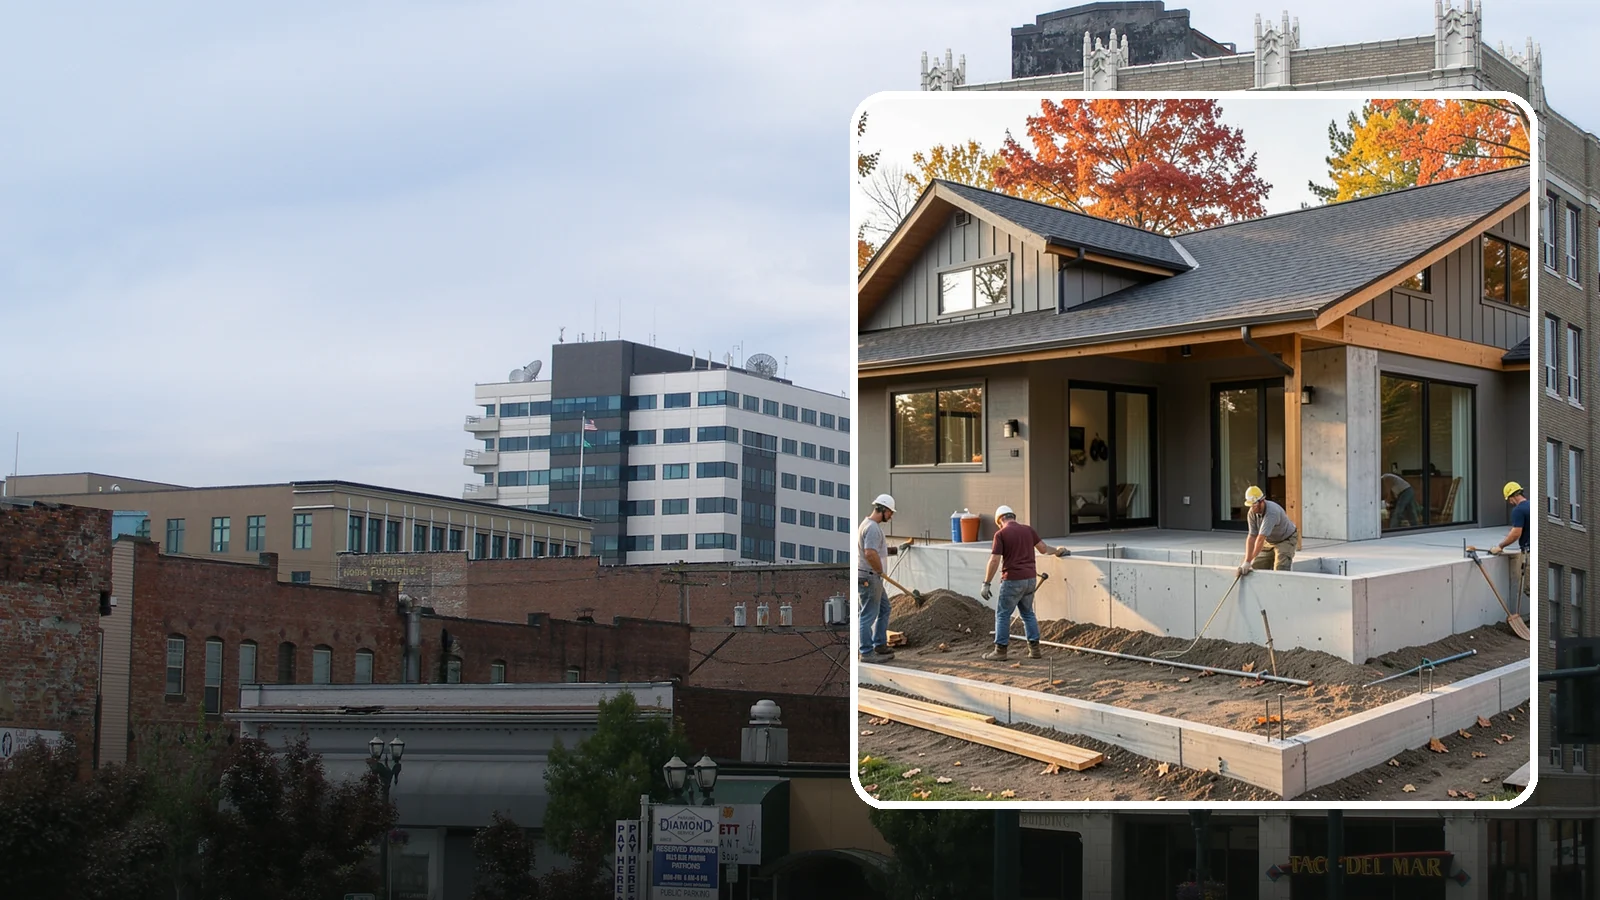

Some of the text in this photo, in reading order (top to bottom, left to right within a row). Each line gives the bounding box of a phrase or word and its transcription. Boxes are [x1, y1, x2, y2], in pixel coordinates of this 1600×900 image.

[343, 566, 427, 577] Home Furnishers
[660, 818, 713, 833] DIAMOND
[1022, 815, 1070, 827] BUILDING
[689, 846, 716, 854] PARKING
[616, 825, 625, 893] PAY HERE
[627, 824, 637, 893] PAY HERE
[721, 852, 739, 862] Soup
[671, 862, 701, 870] PATRONS
[1289, 855, 1442, 877] TAC DEL MAR
[660, 888, 710, 898] PUBLIC PARKING
